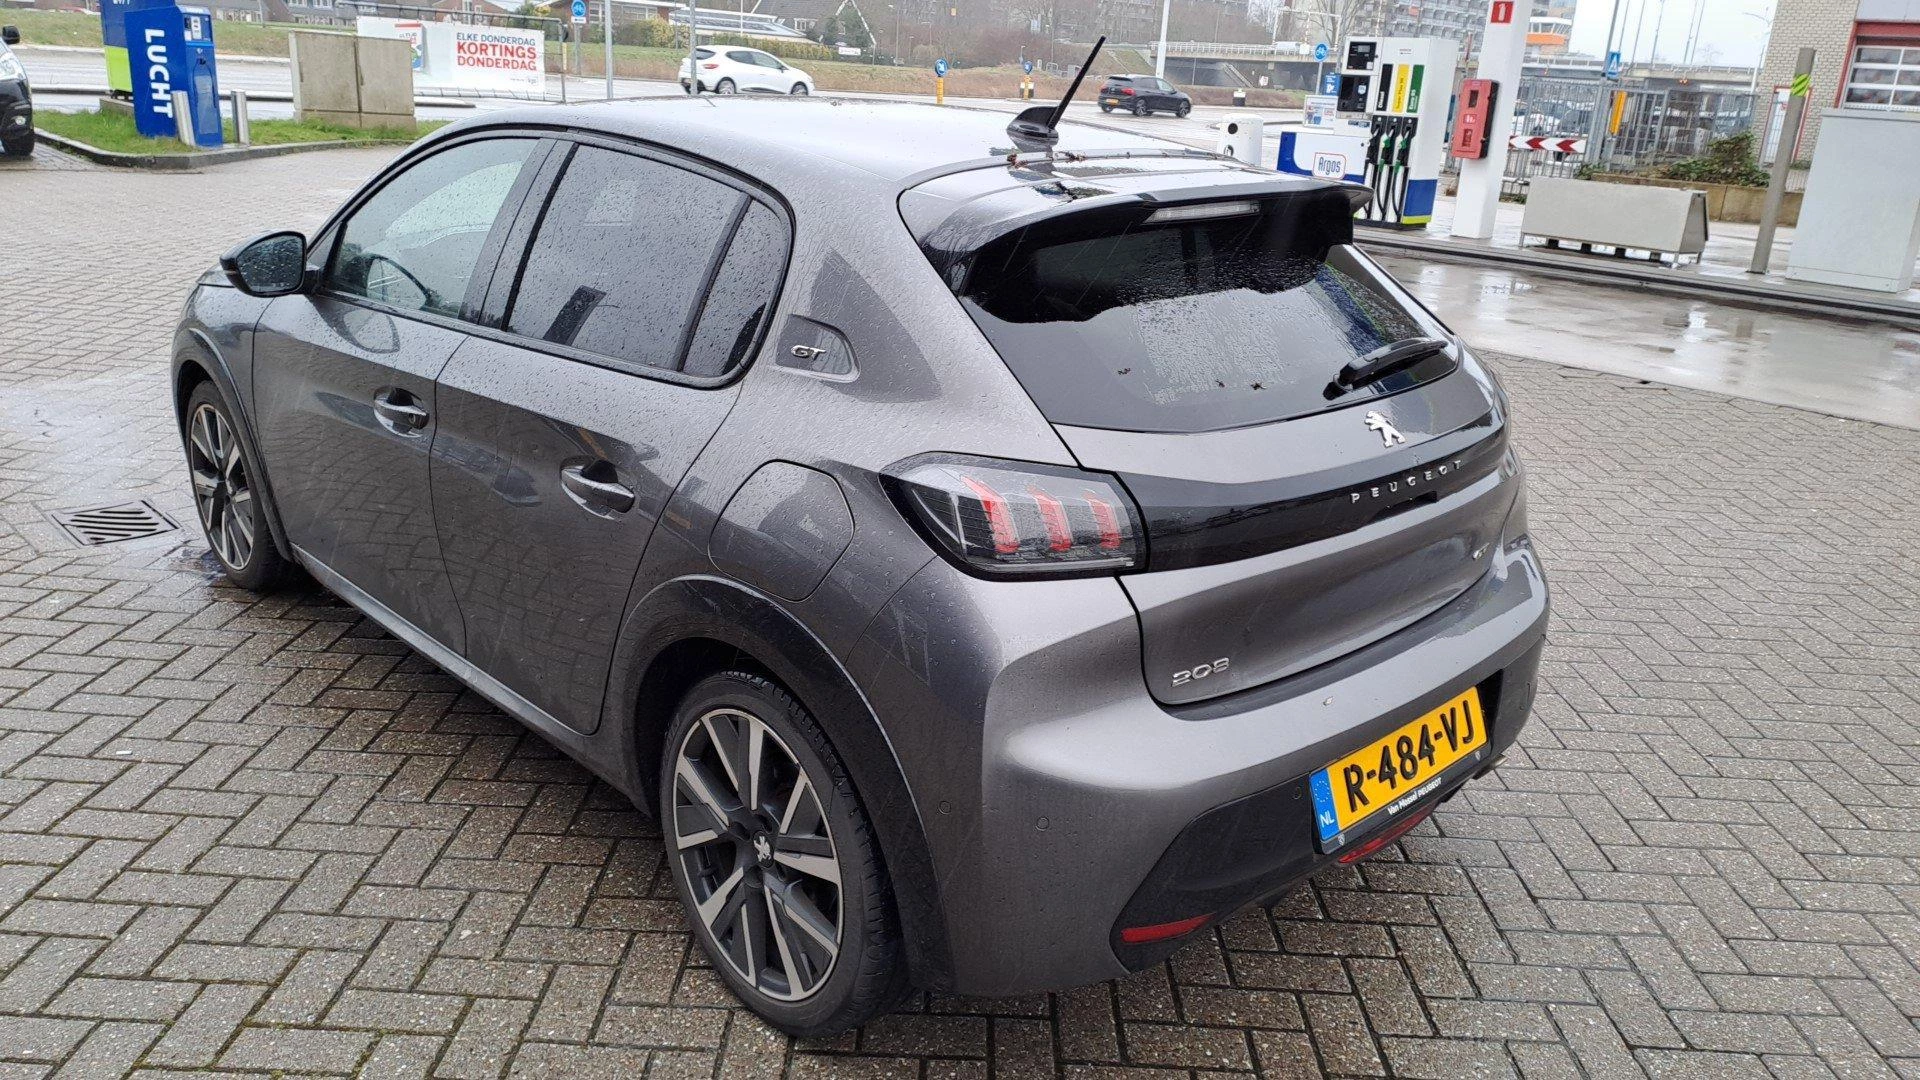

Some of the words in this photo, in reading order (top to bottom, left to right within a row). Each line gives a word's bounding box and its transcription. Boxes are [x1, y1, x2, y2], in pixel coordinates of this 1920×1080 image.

[1498, 3, 1507, 22] 1
[456, 32, 478, 42] ELKE
[481, 33, 536, 46] DONDERDAG
[456, 42, 537, 59] KORTINGS
[457, 56, 537, 71] DONDERDAG
[144, 28, 173, 119] LUCHT
[1318, 156, 1341, 175] Argos
[790, 344, 827, 361] GT
[1350, 460, 1461, 504] PEUGEOT
[1171, 657, 1230, 687] 208
[1343, 699, 1475, 813] R-484-VJ
[1387, 804, 1400, 815] Van
[1319, 810, 1335, 828] NL
